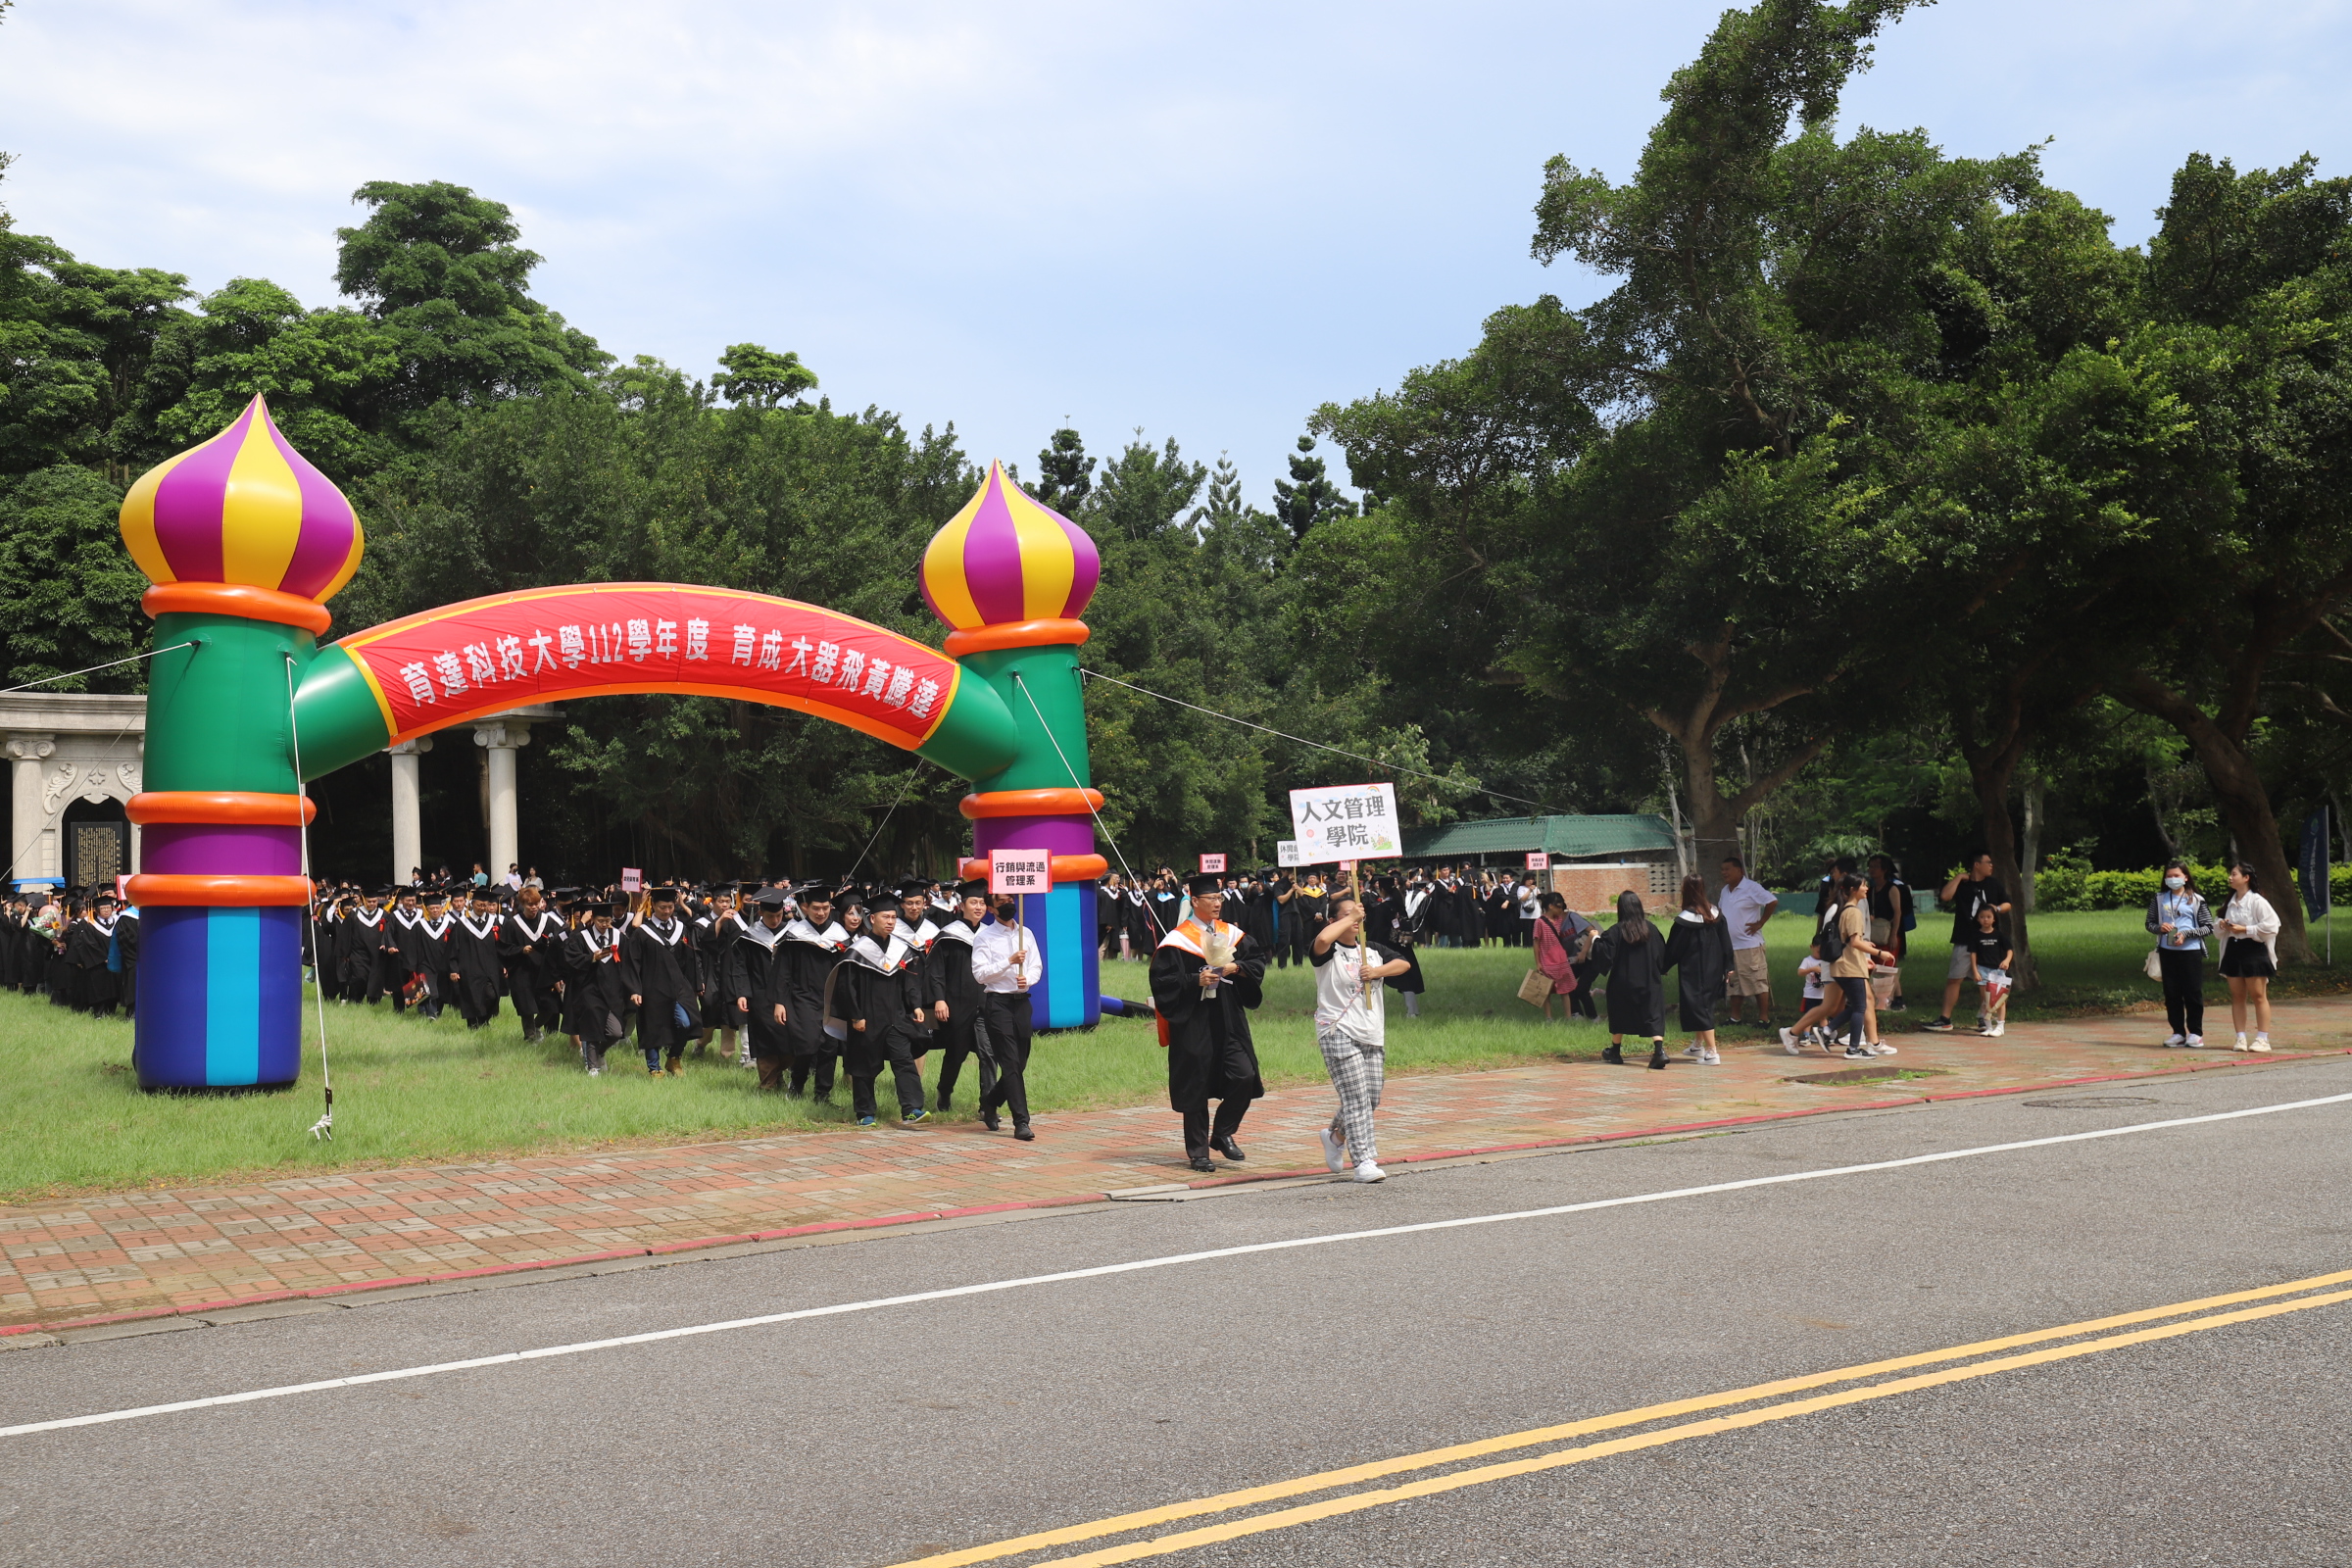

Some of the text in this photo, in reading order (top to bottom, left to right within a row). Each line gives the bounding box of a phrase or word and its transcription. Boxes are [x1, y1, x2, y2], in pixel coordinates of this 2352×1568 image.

[399, 616, 940, 720] 育達科技大學112學年度 育成大器飛黃騰達
[1300, 795, 1386, 824] 人文管理
[1326, 823, 1370, 849] 學院
[995, 861, 1046, 873] 行銷與流通
[1005, 875, 1036, 886] 管理系
